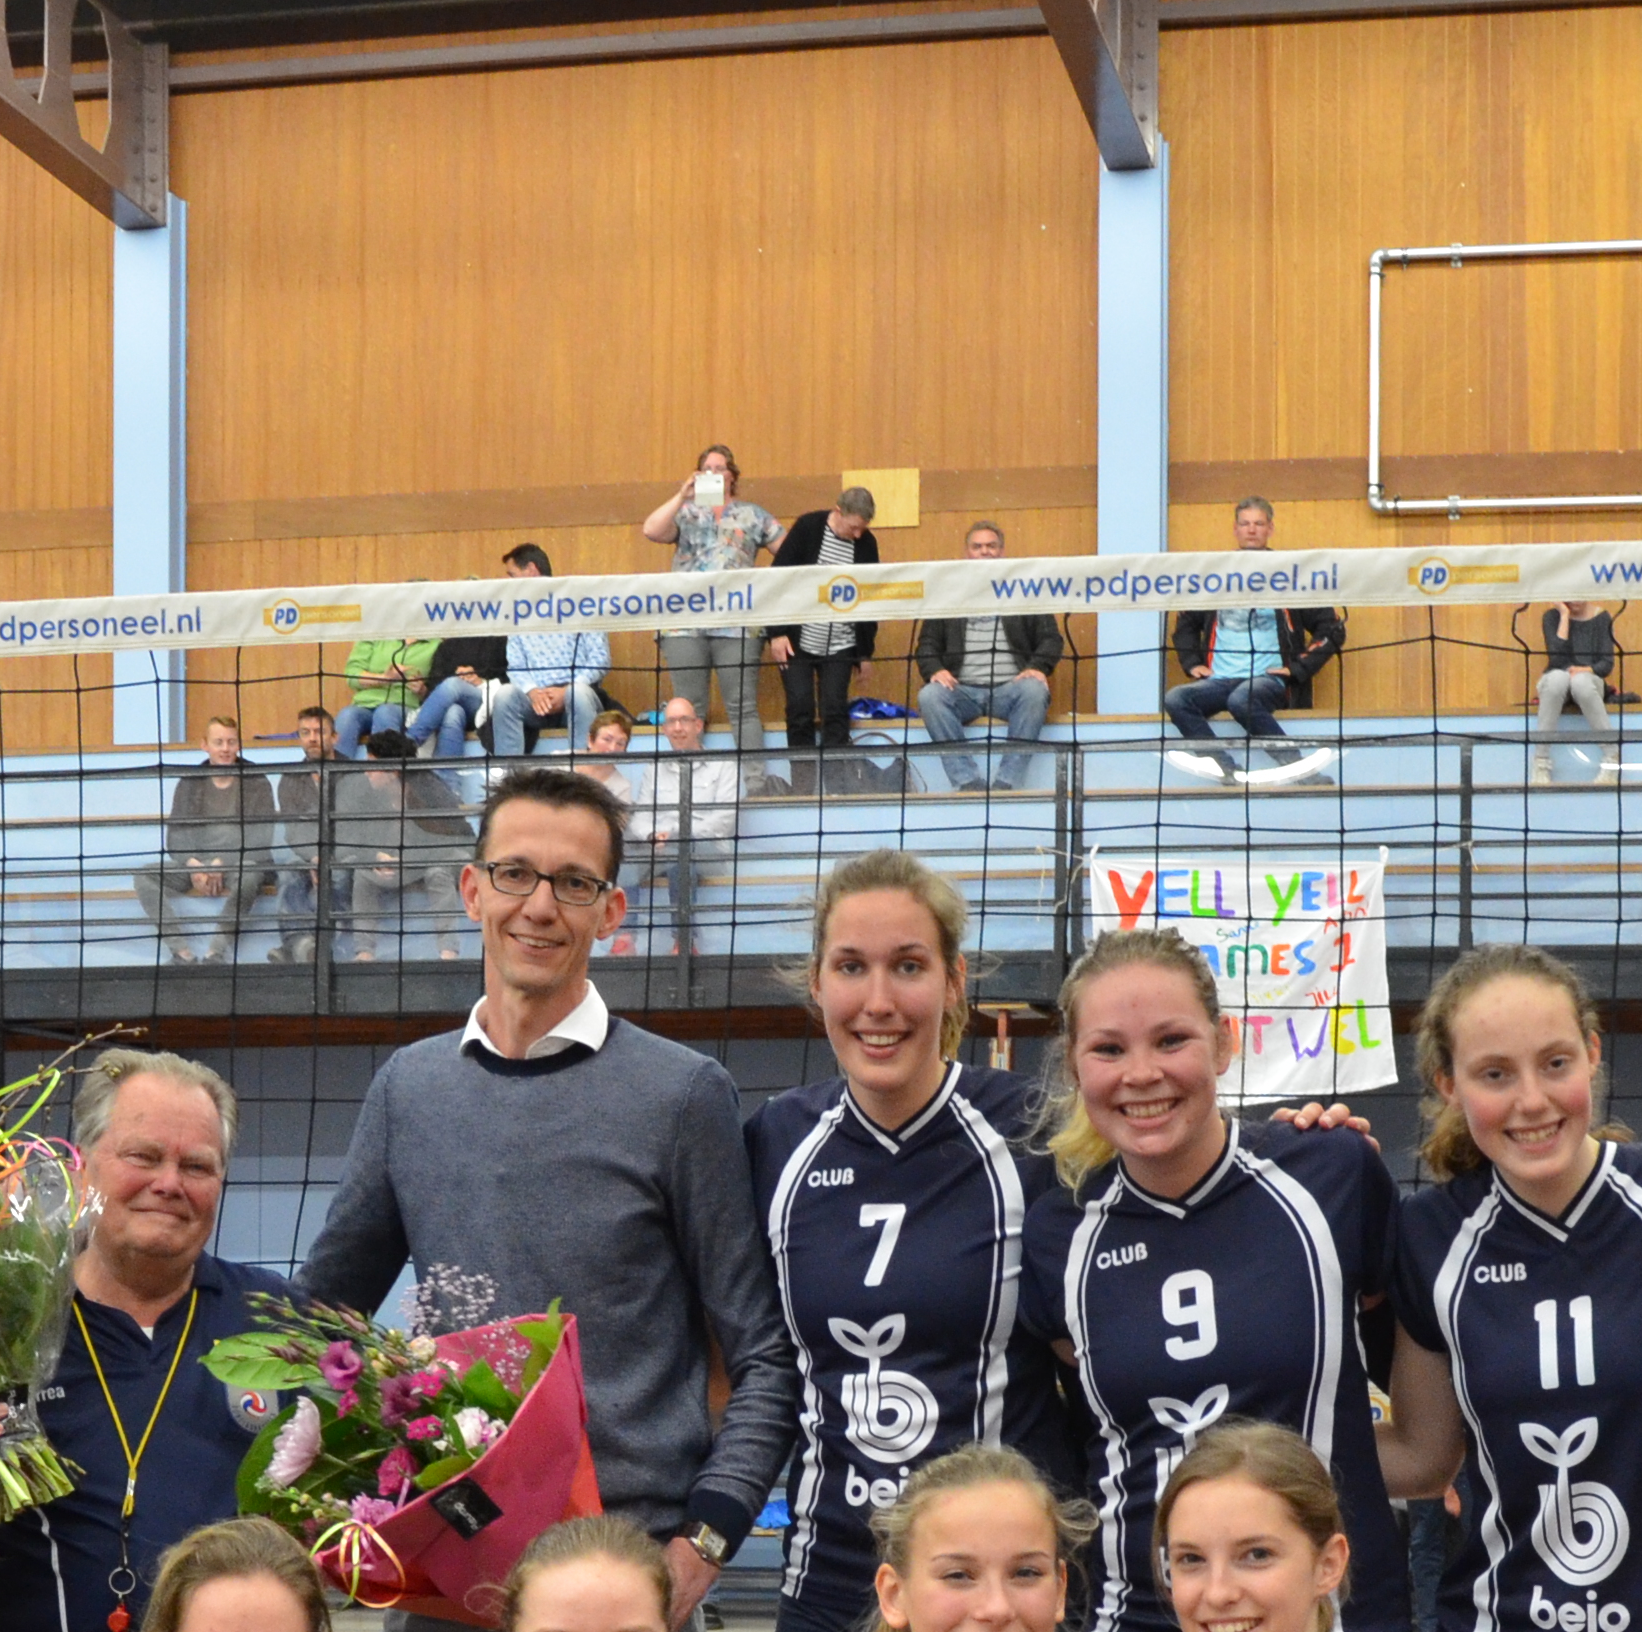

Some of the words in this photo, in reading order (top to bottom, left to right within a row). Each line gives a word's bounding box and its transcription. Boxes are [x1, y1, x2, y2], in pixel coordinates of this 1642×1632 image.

[831, 584, 856, 603] PD
[991, 566, 1338, 603] www.pdpersoneel.nl
[1421, 566, 1448, 586] PD
[274, 607, 298, 625] PD
[425, 584, 753, 624] www.pdpersoneel.nl
[1265, 870, 1364, 926] YELL
[1287, 999, 1381, 1061] WEL
[807, 1168, 855, 1188] CLUB
[859, 1203, 907, 1287] 7
[1096, 1242, 1148, 1270] CLUB
[1473, 1262, 1527, 1284] CLUB
[1161, 1269, 1218, 1361] 9
[1533, 1295, 1596, 1390] 11
